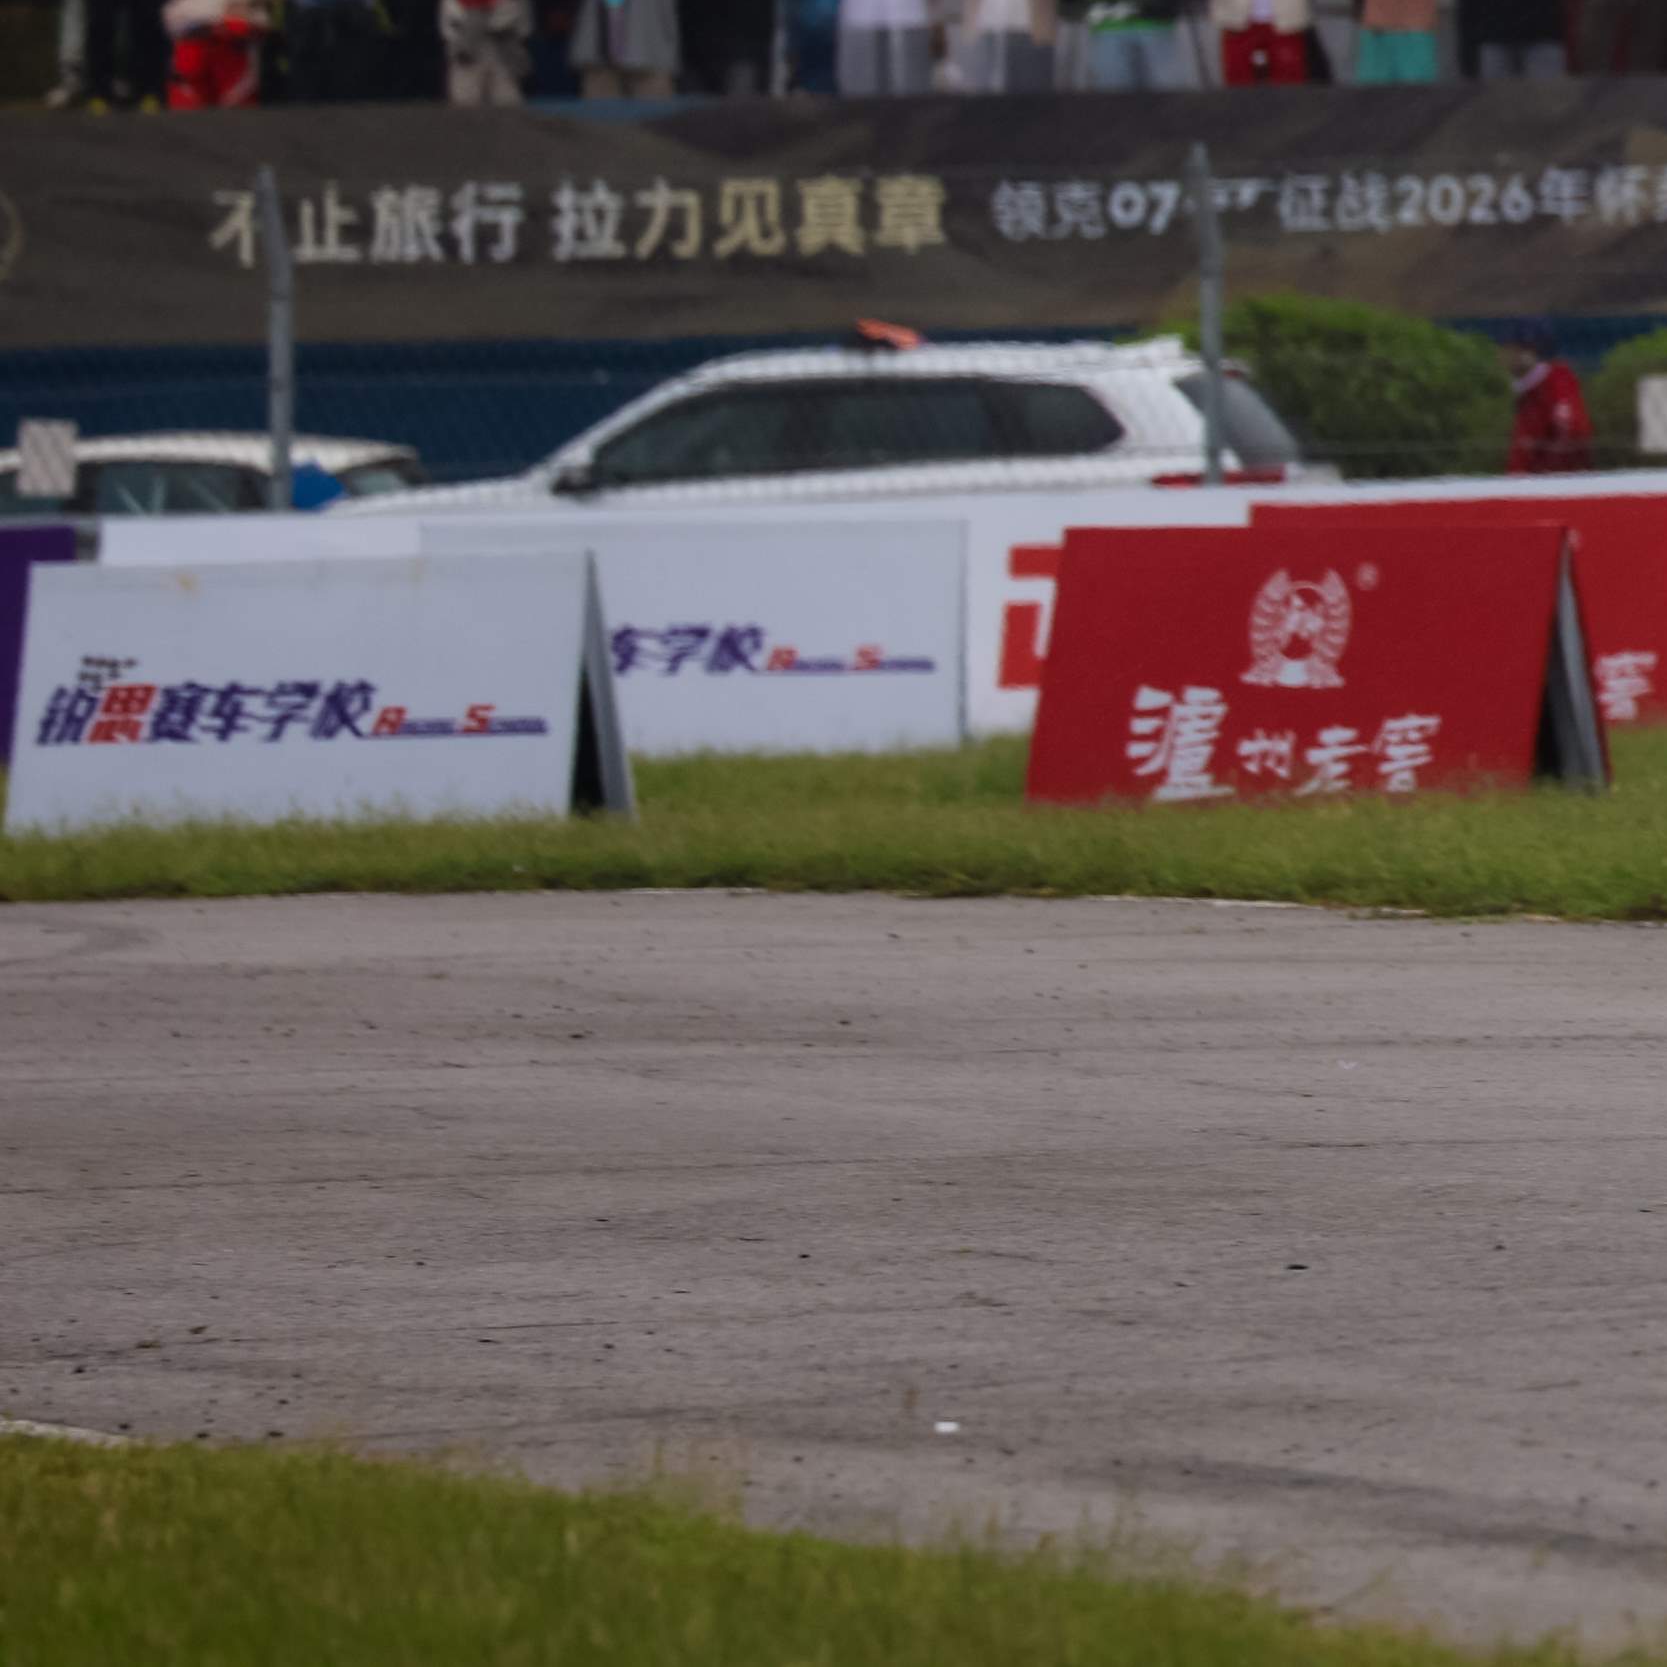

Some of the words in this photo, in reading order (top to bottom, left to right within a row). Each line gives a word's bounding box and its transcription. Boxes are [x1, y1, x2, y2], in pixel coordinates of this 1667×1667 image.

[551, 172, 947, 264] 拉力见真章
[36, 679, 376, 746] 锐思赛车学校
